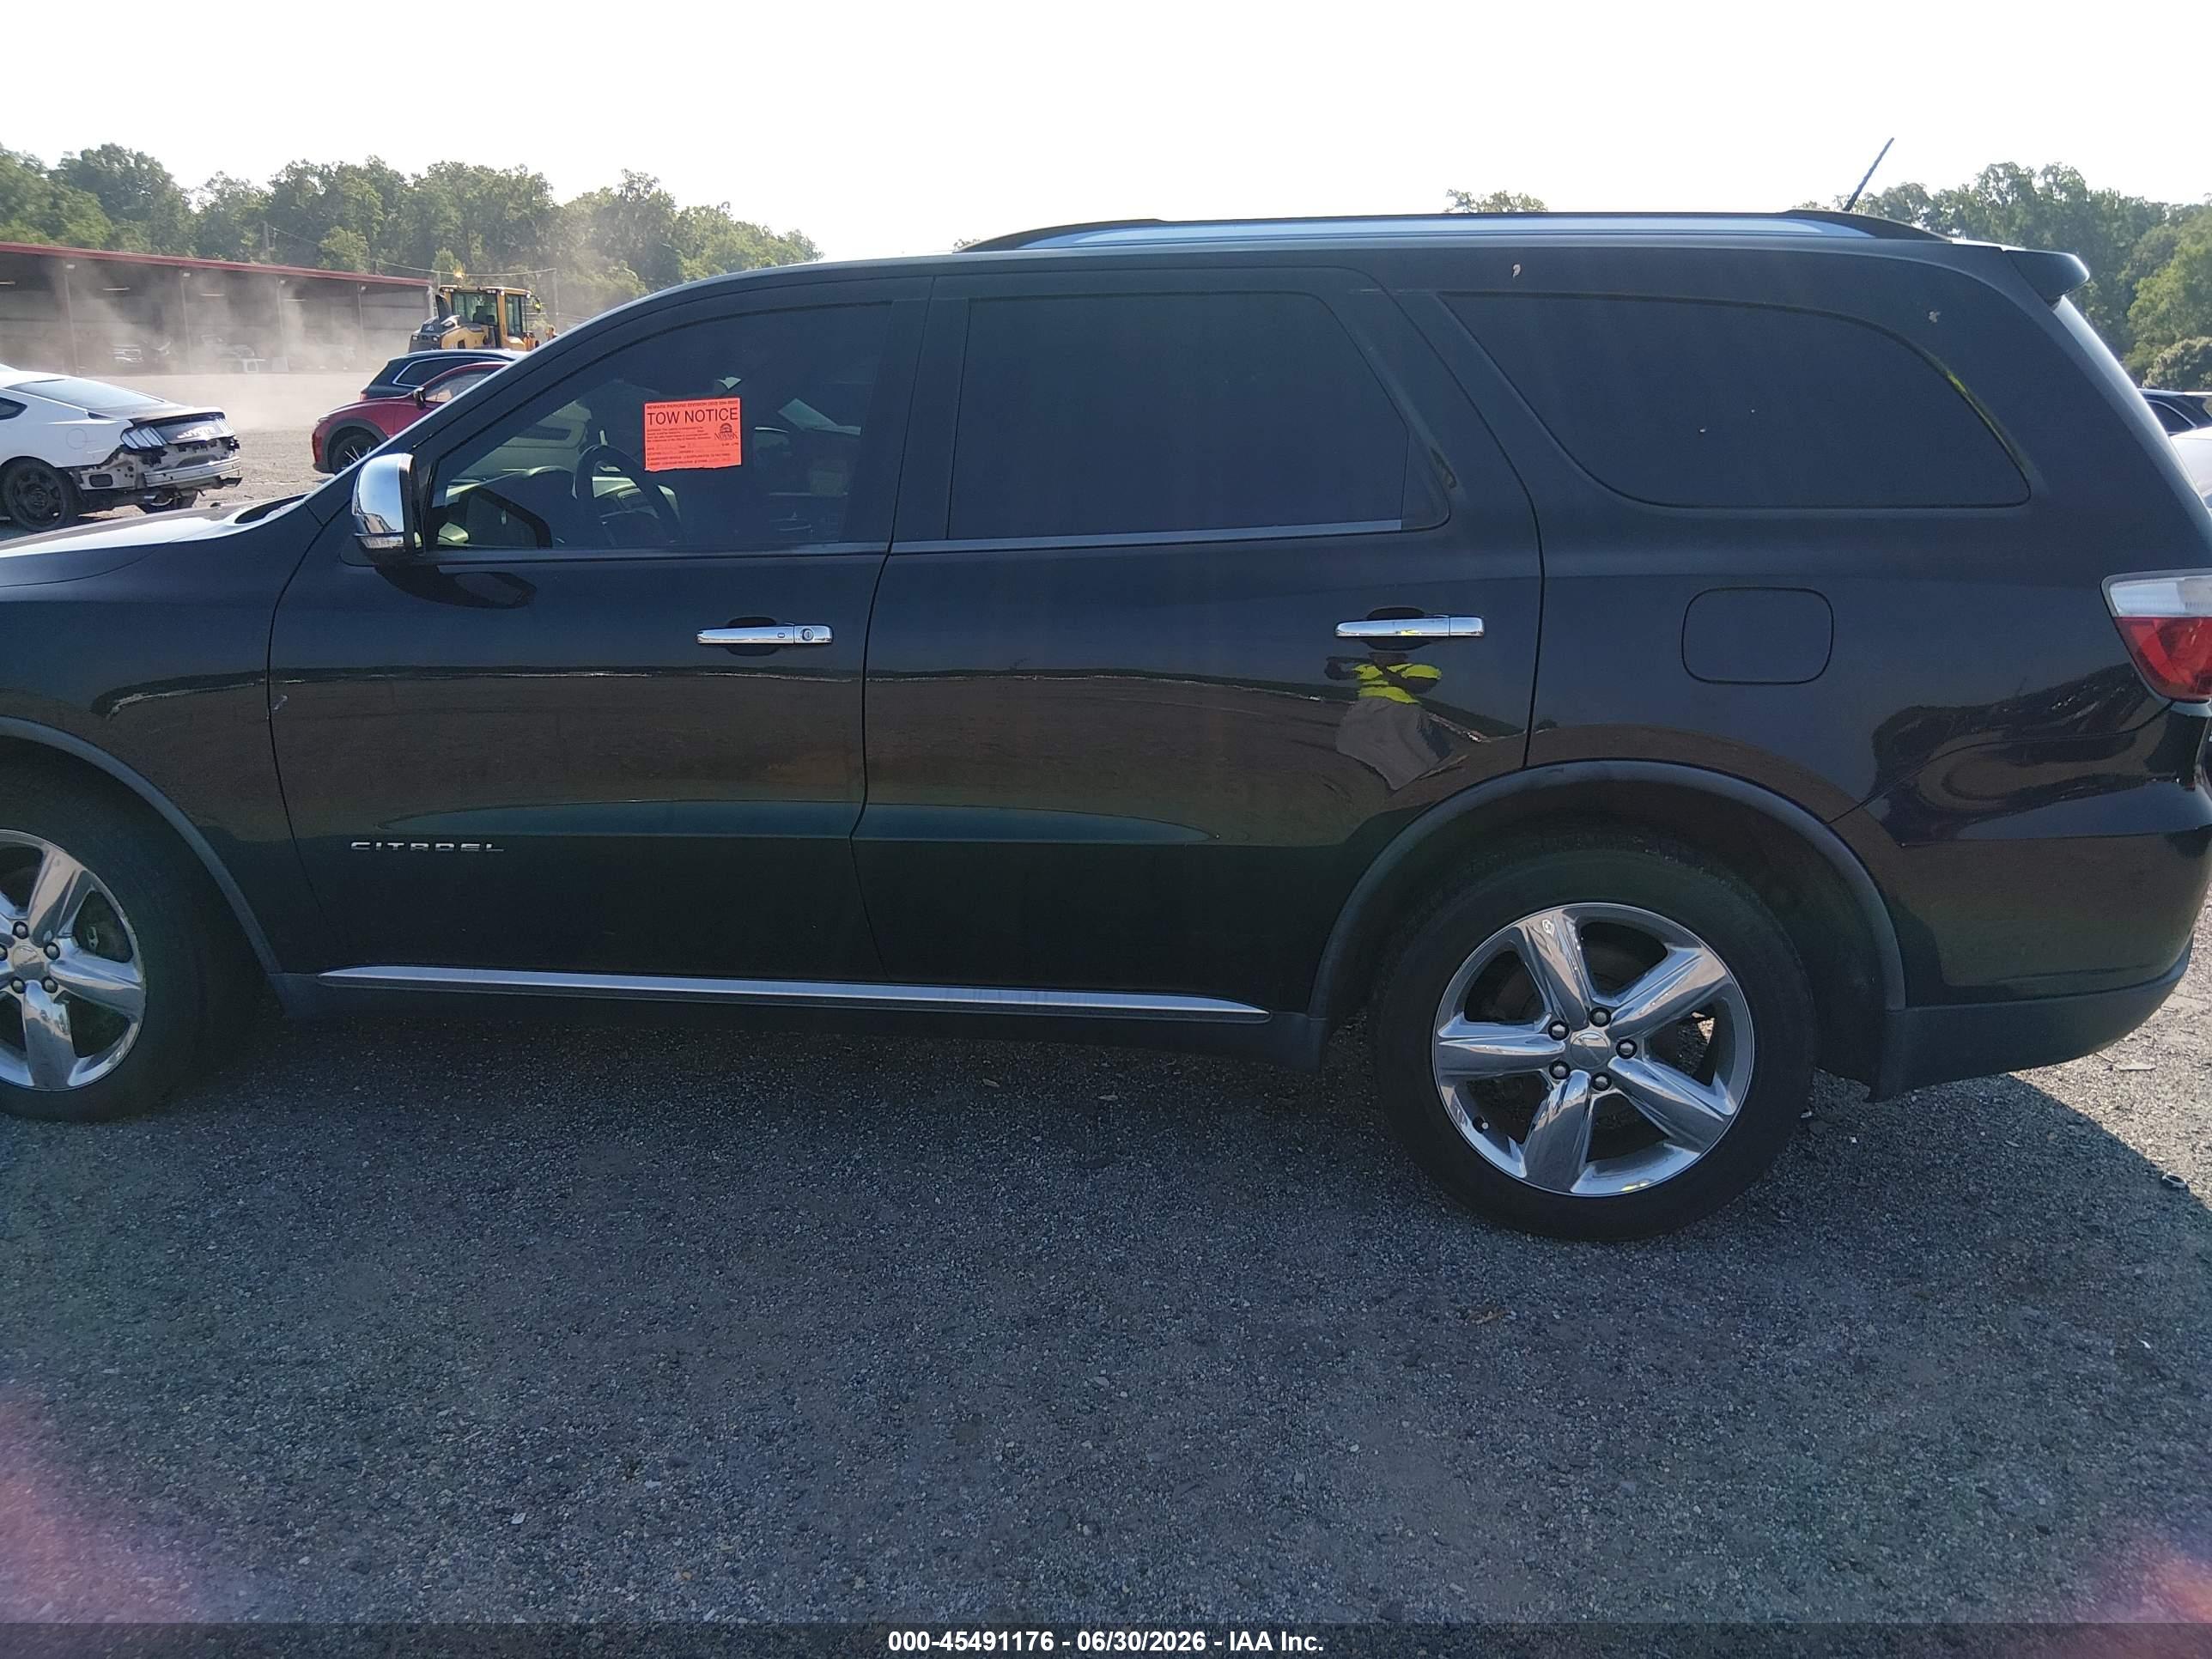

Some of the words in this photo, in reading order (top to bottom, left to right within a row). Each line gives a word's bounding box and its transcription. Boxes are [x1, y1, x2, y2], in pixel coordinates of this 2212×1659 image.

[647, 411, 680, 426] TOW
[684, 407, 738, 423] NOTICE
[350, 842, 505, 852] CITADEL
